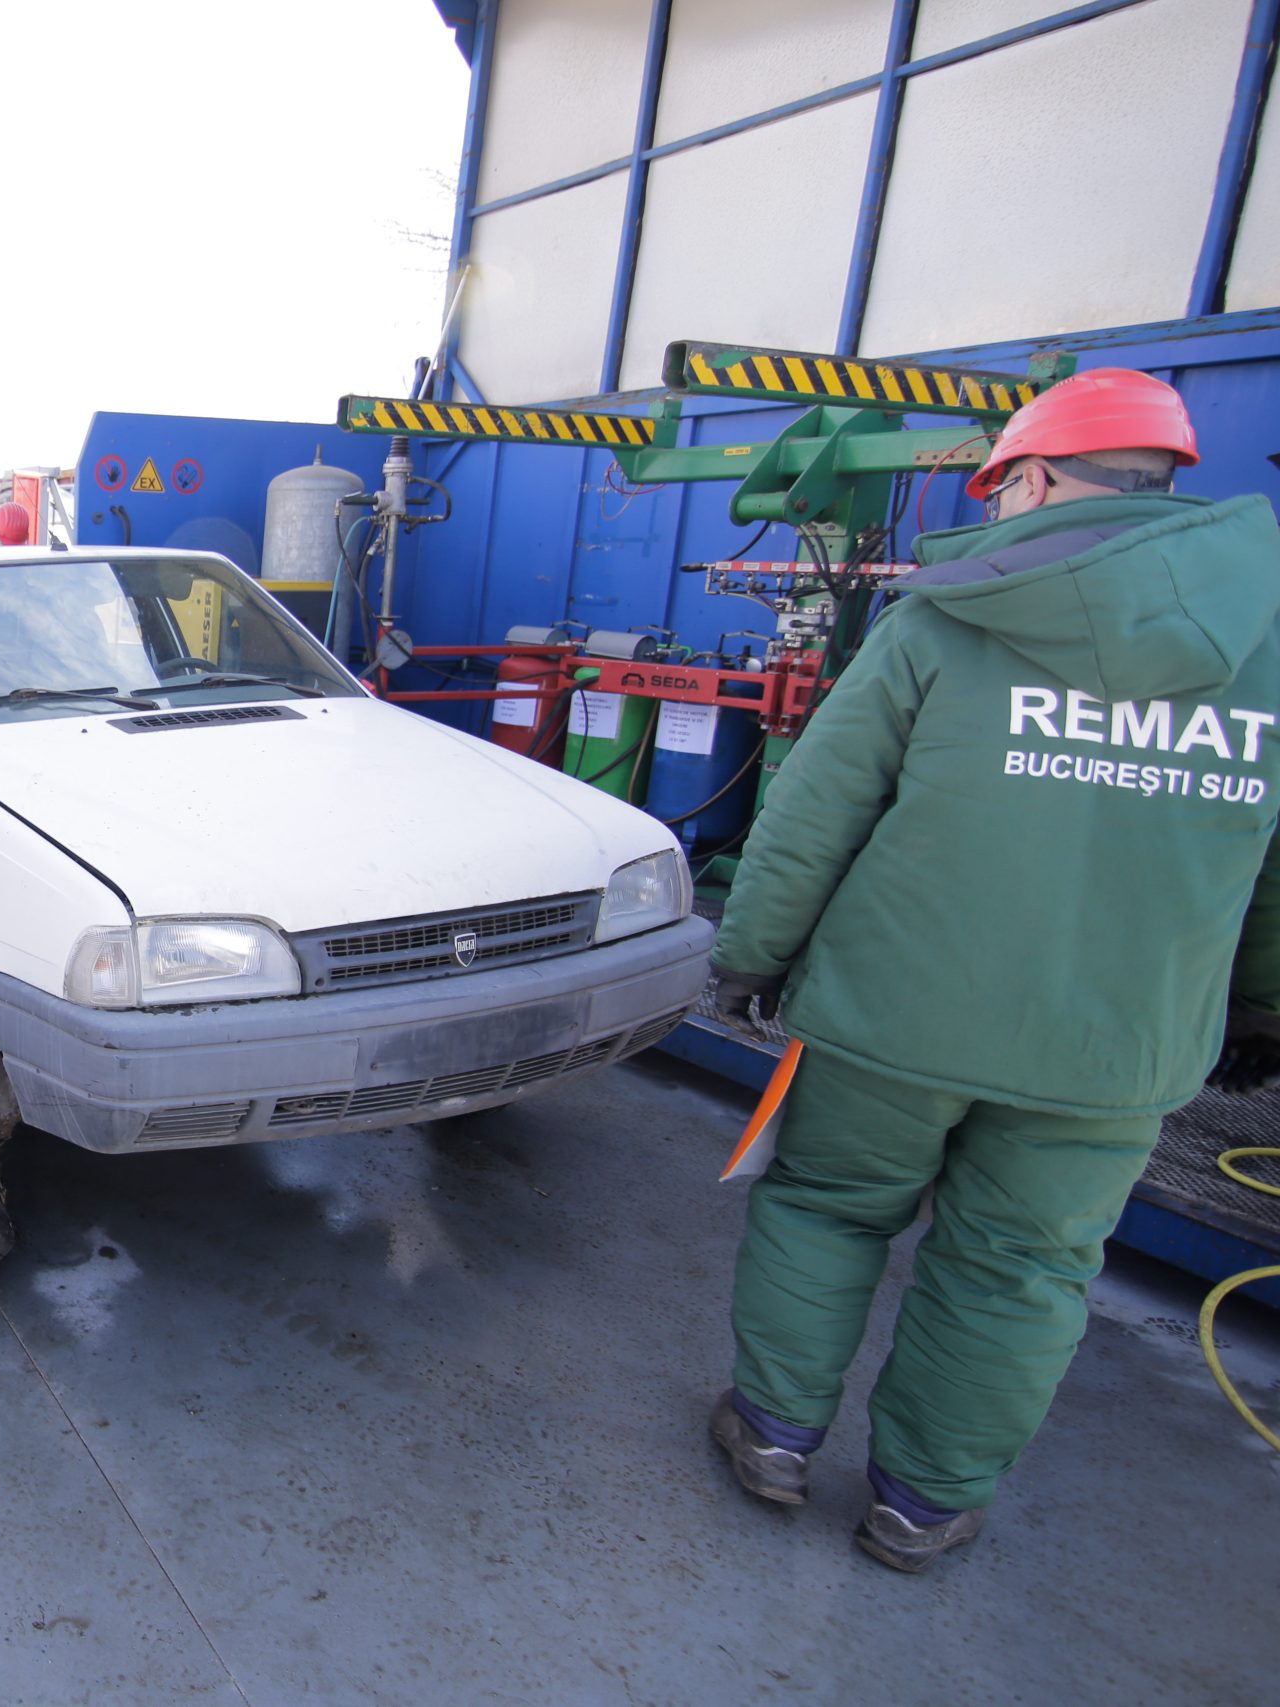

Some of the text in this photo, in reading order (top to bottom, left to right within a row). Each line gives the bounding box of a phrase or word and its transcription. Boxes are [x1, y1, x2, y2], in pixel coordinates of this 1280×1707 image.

[140, 477, 156, 489] EX
[202, 591, 212, 660] AESER
[650, 675, 699, 691] SEDA
[1009, 686, 1274, 763] REMAT
[1003, 750, 1266, 804] BUCUREŞTI SUD
[457, 939, 475, 952] DACIA
